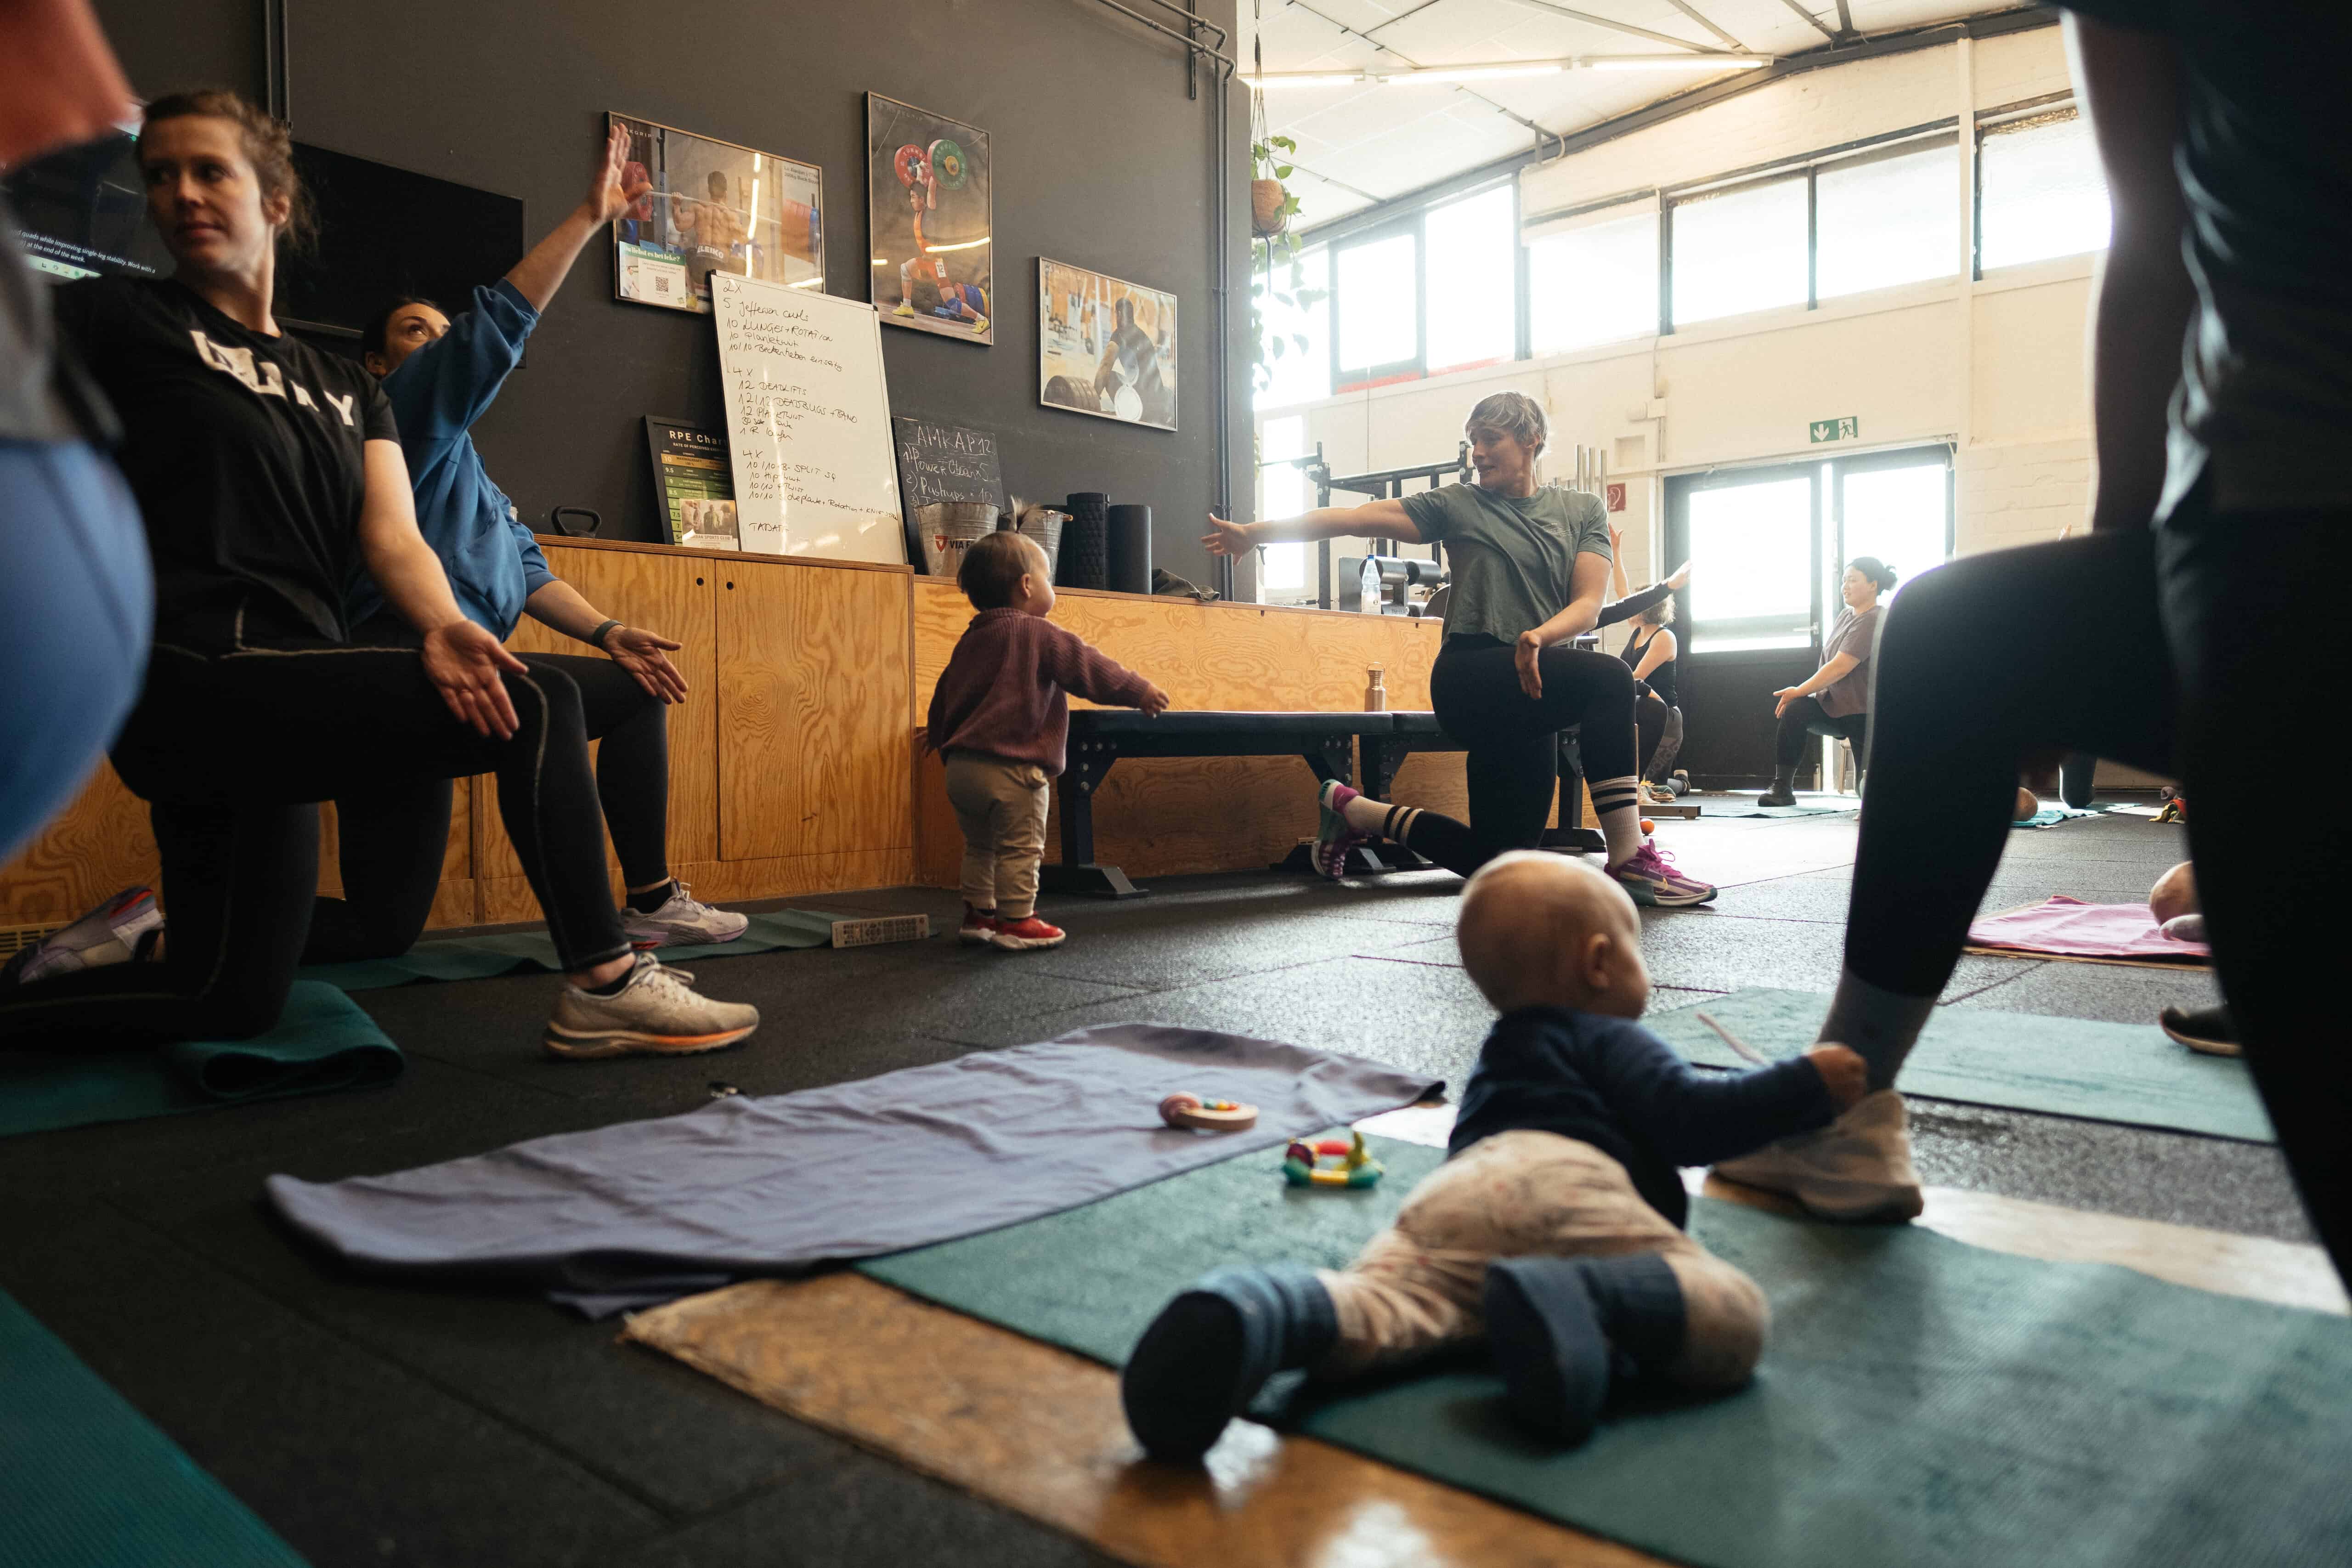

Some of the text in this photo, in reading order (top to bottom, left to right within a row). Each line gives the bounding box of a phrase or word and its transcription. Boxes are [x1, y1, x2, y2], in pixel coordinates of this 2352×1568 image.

[22, 231, 39, 240] quads
[40, 236, 54, 244] while
[82, 248, 106, 260] single-leg
[106, 255, 127, 266] stability.
[128, 261, 141, 269] Work
[43, 246, 55, 255] end
[61, 250, 69, 258] the
[70, 254, 85, 263] week.
[696, 246, 724, 259] ELEIKO
[936, 264, 944, 272] 12
[723, 298, 731, 308] 5
[727, 318, 738, 328] 10
[729, 332, 739, 341] 10
[739, 380, 755, 390] 12
[740, 406, 753, 416] 12
[669, 430, 692, 441] RPE
[740, 427, 746, 436] 1
[794, 464, 821, 475] SPLIT
[750, 472, 760, 481] 10
[950, 540, 964, 549] VIA
